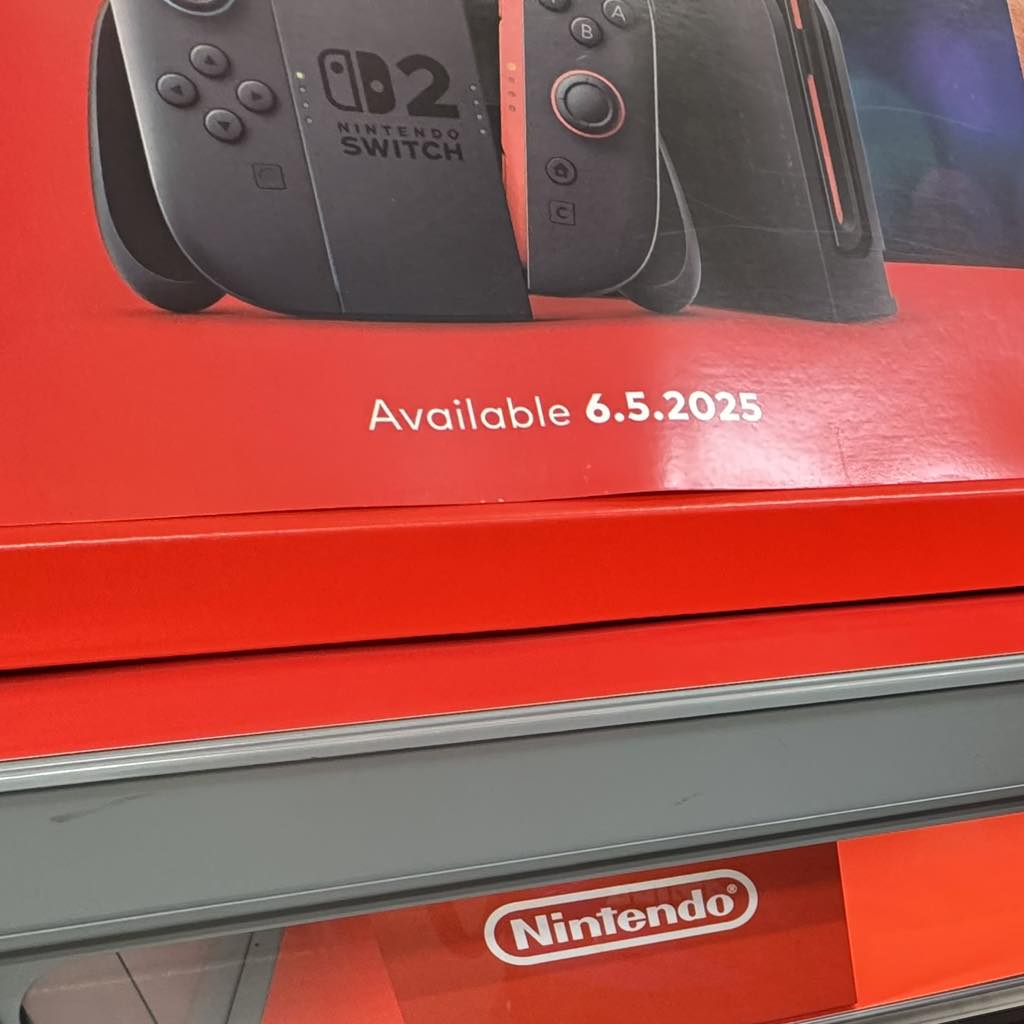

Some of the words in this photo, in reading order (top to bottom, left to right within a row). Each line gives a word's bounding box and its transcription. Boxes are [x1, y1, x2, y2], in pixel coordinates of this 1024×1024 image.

[611, 5, 626, 22] A
[582, 24, 593, 39] B
[396, 54, 460, 119] 2
[338, 121, 460, 140] NINTENDO
[340, 136, 464, 161] SWITCH
[555, 206, 569, 220] C
[369, 397, 571, 431] Available
[585, 390, 762, 424] 6.5.2025
